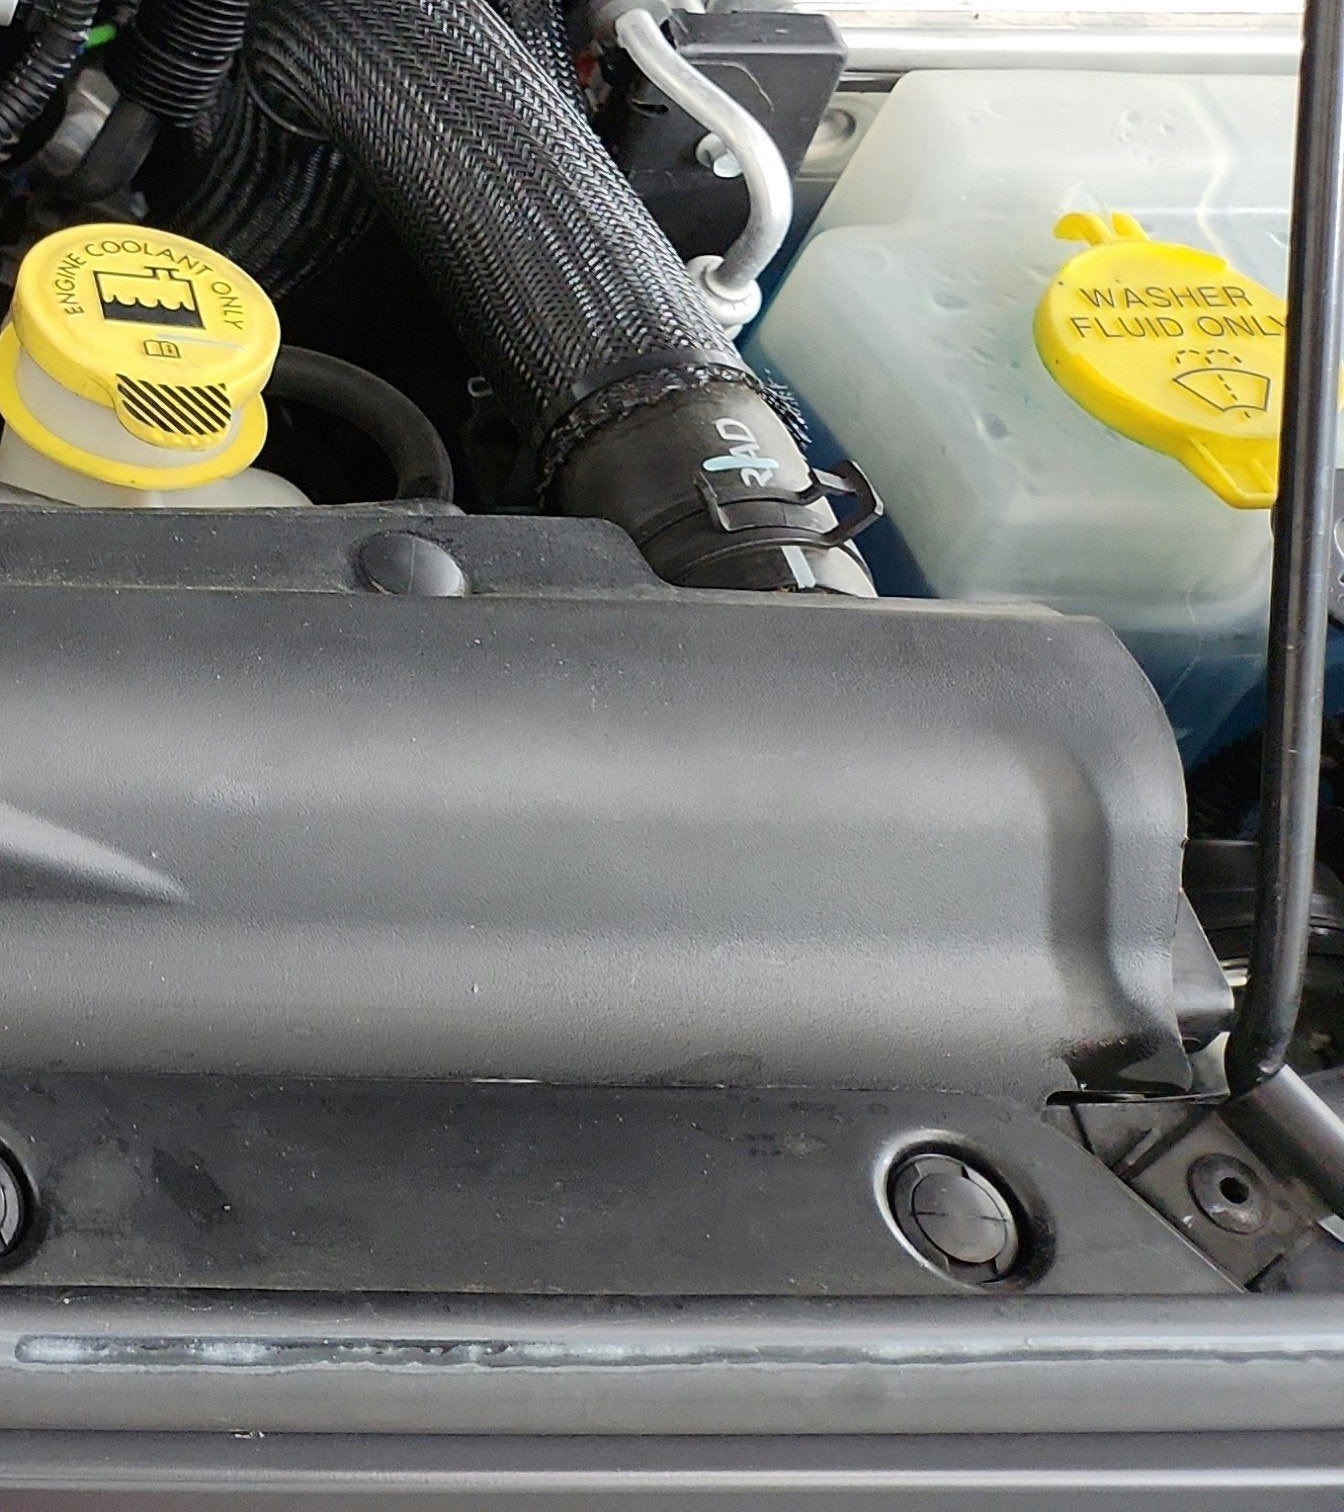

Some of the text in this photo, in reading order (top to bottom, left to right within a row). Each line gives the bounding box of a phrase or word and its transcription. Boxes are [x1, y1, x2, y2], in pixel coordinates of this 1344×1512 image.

[54, 239, 244, 331] ENGINE COOLANT ONLY
[1078, 285, 1254, 309] WASHER
[1069, 316, 1185, 339] FLUID
